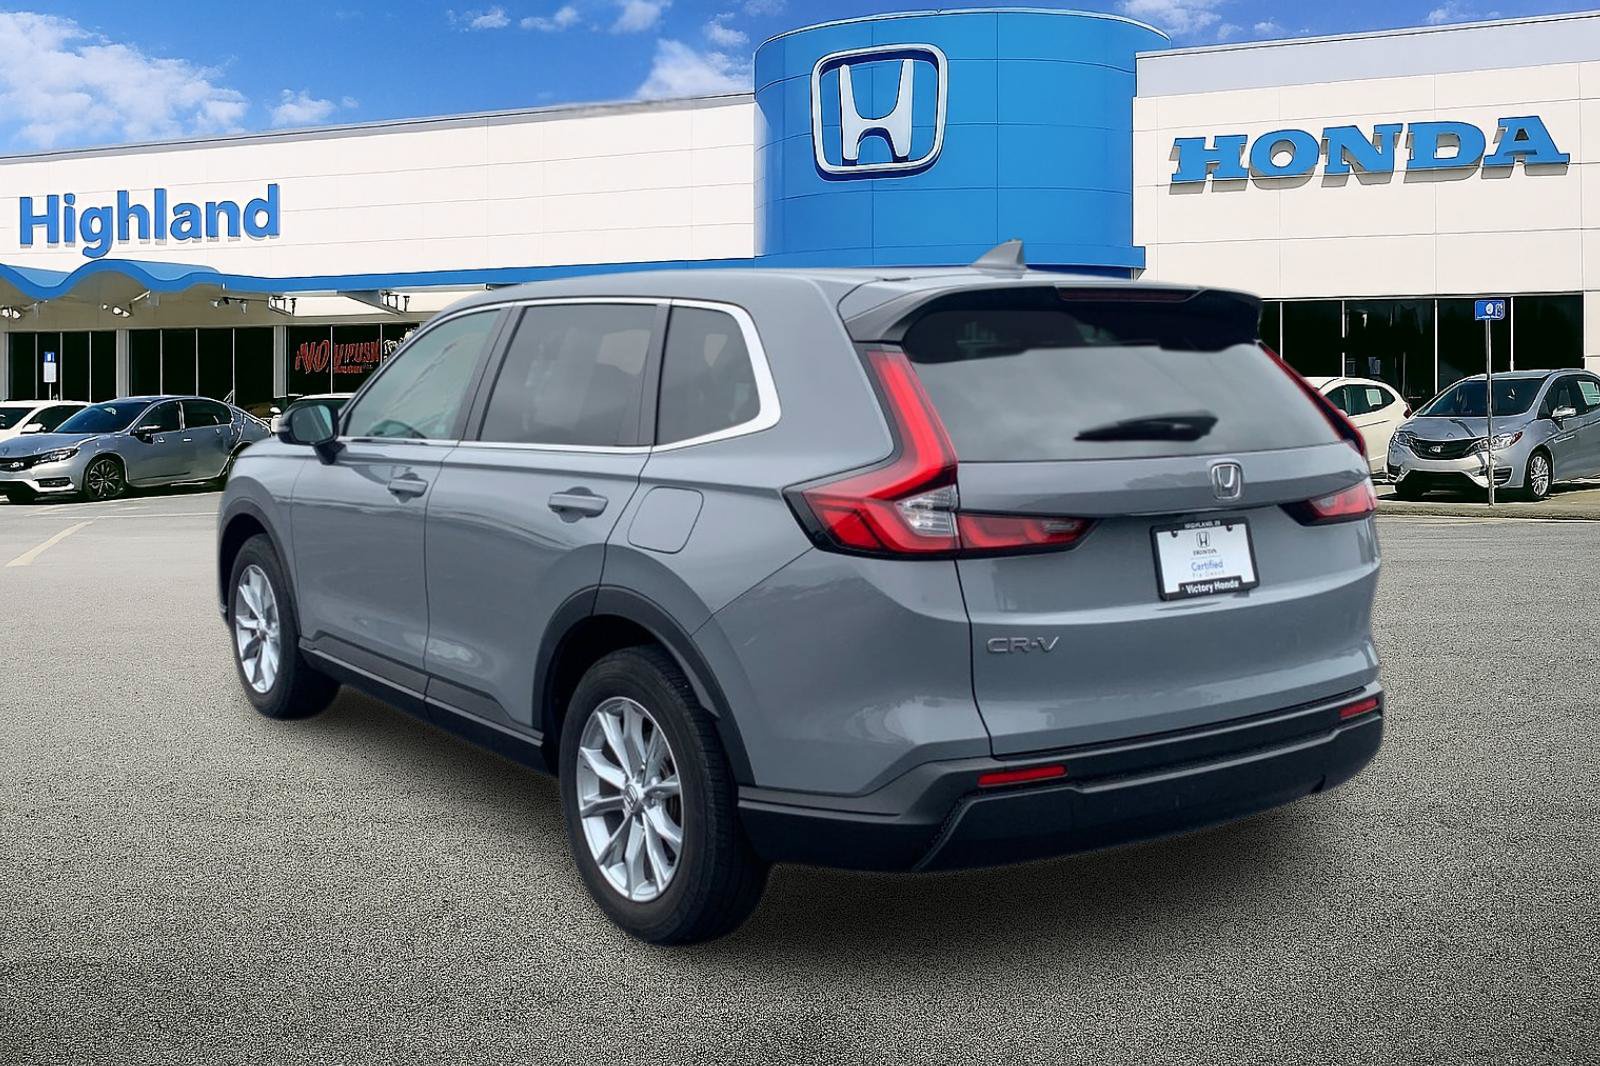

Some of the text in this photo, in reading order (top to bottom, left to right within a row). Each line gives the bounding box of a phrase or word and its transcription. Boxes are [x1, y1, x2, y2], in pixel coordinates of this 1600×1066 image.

[1171, 115, 1570, 184] HONDA
[19, 183, 280, 259] Highland
[1191, 559, 1223, 572] Certified
[1185, 579, 1239, 594] Victory Honda
[987, 636, 1059, 653] CR-V
